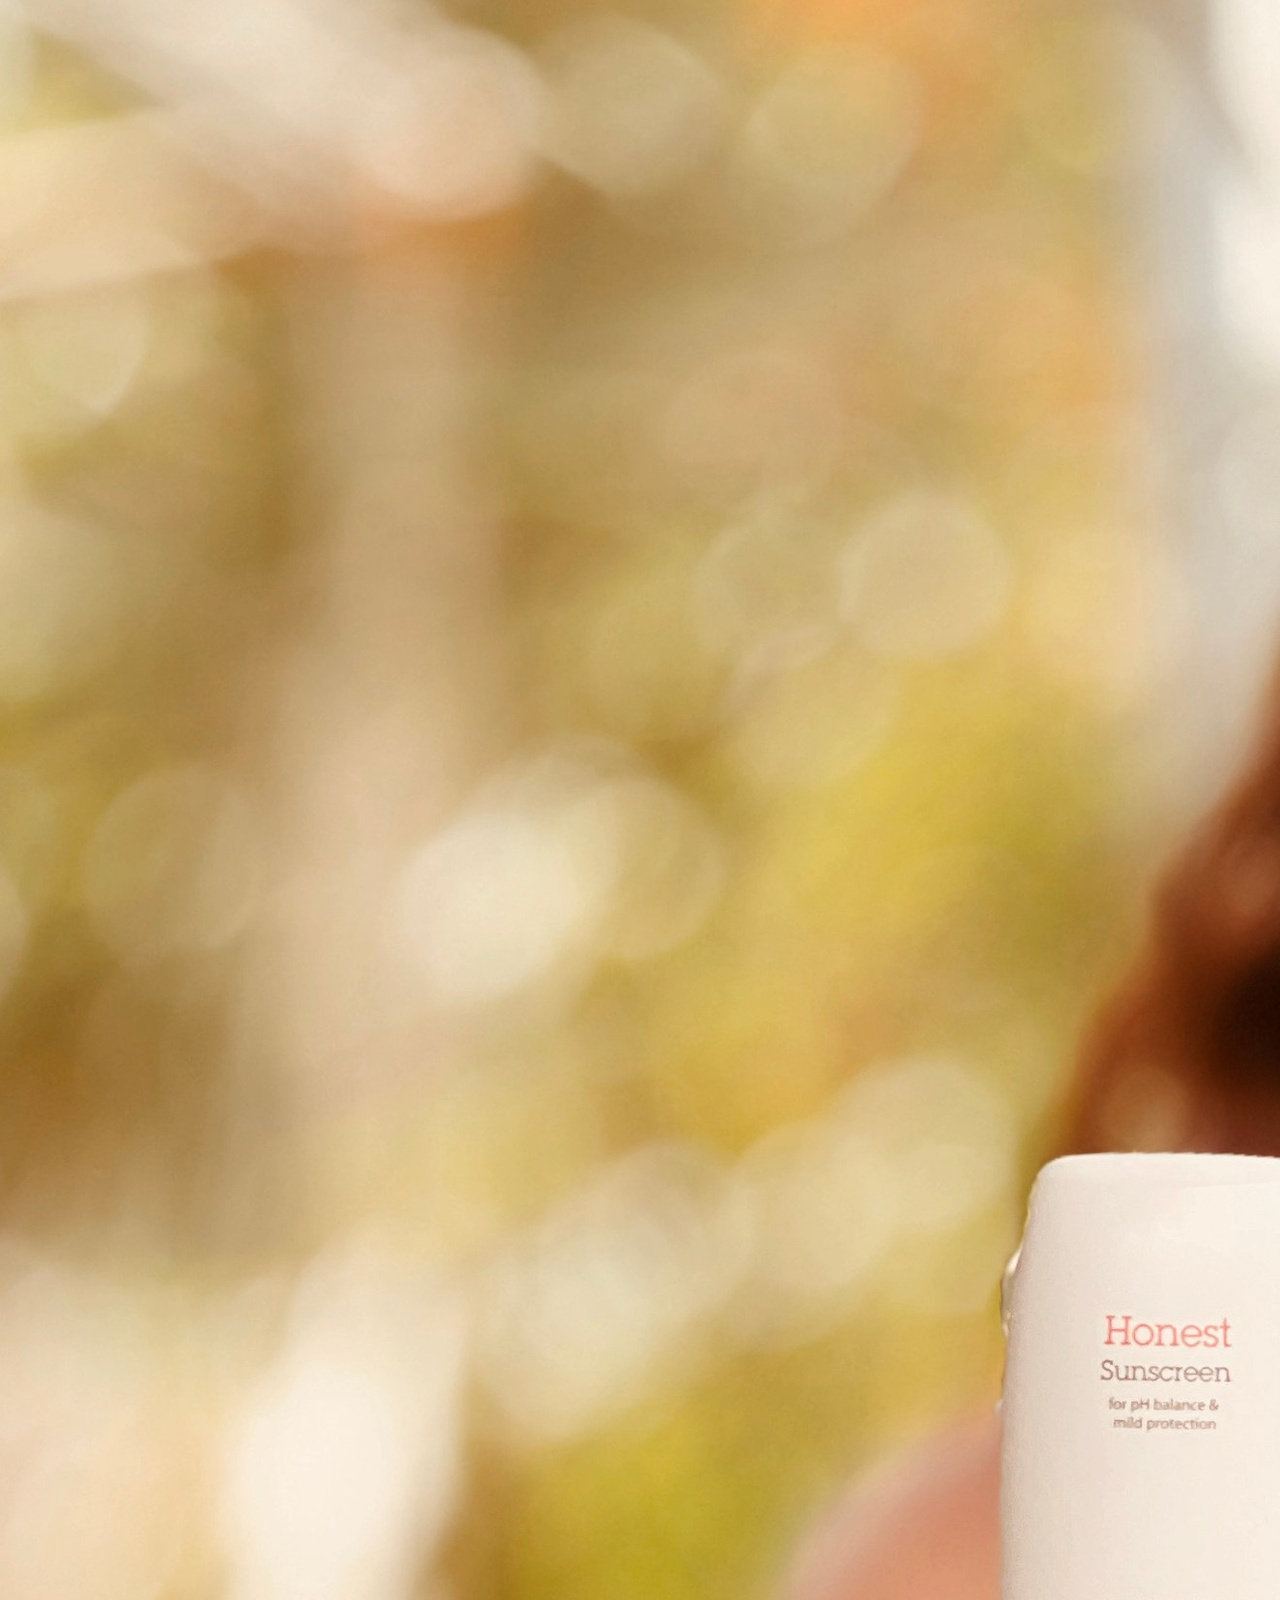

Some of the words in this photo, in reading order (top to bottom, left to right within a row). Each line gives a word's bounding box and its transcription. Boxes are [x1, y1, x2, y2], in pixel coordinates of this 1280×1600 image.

[1103, 1314, 1232, 1348] Honest
[1100, 1359, 1232, 1383] Sunscreen
[1108, 1397, 1127, 1411] for
[1130, 1399, 1150, 1413] pH
[1153, 1398, 1206, 1411] balance
[1208, 1398, 1220, 1412] &
[1113, 1416, 1143, 1430] mild
[1146, 1418, 1217, 1432] protection
